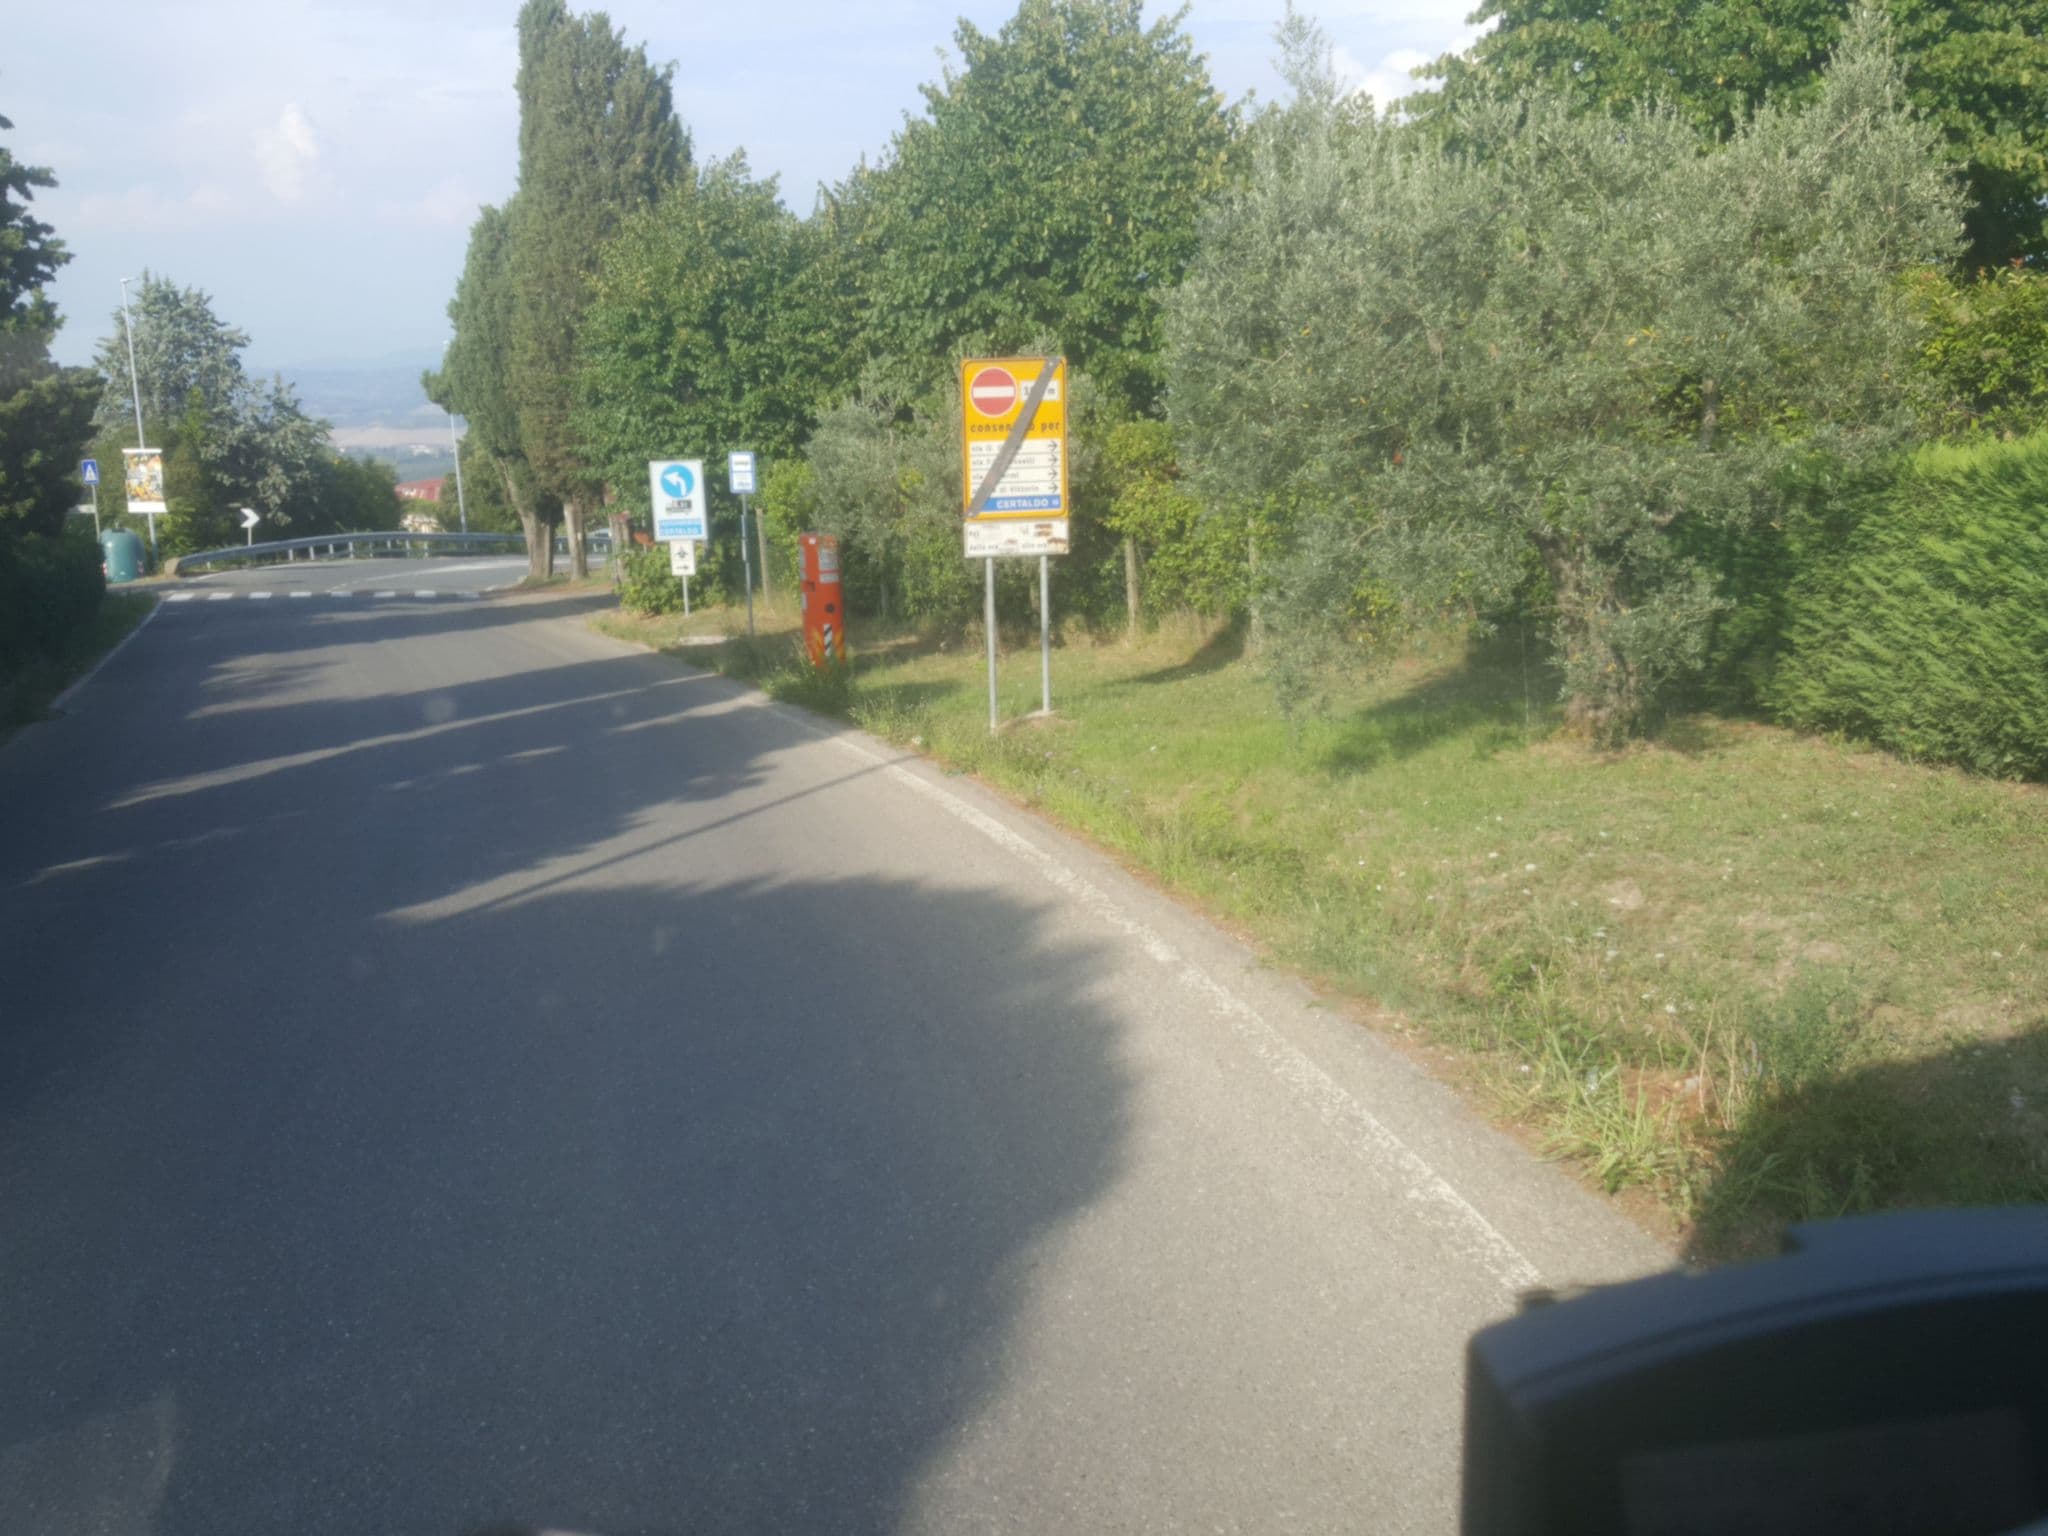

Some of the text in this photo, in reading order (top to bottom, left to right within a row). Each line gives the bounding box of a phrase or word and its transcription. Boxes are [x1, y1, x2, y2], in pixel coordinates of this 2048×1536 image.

[970, 421, 1060, 433] conseno per
[997, 499, 1048, 509] CERTALDO
